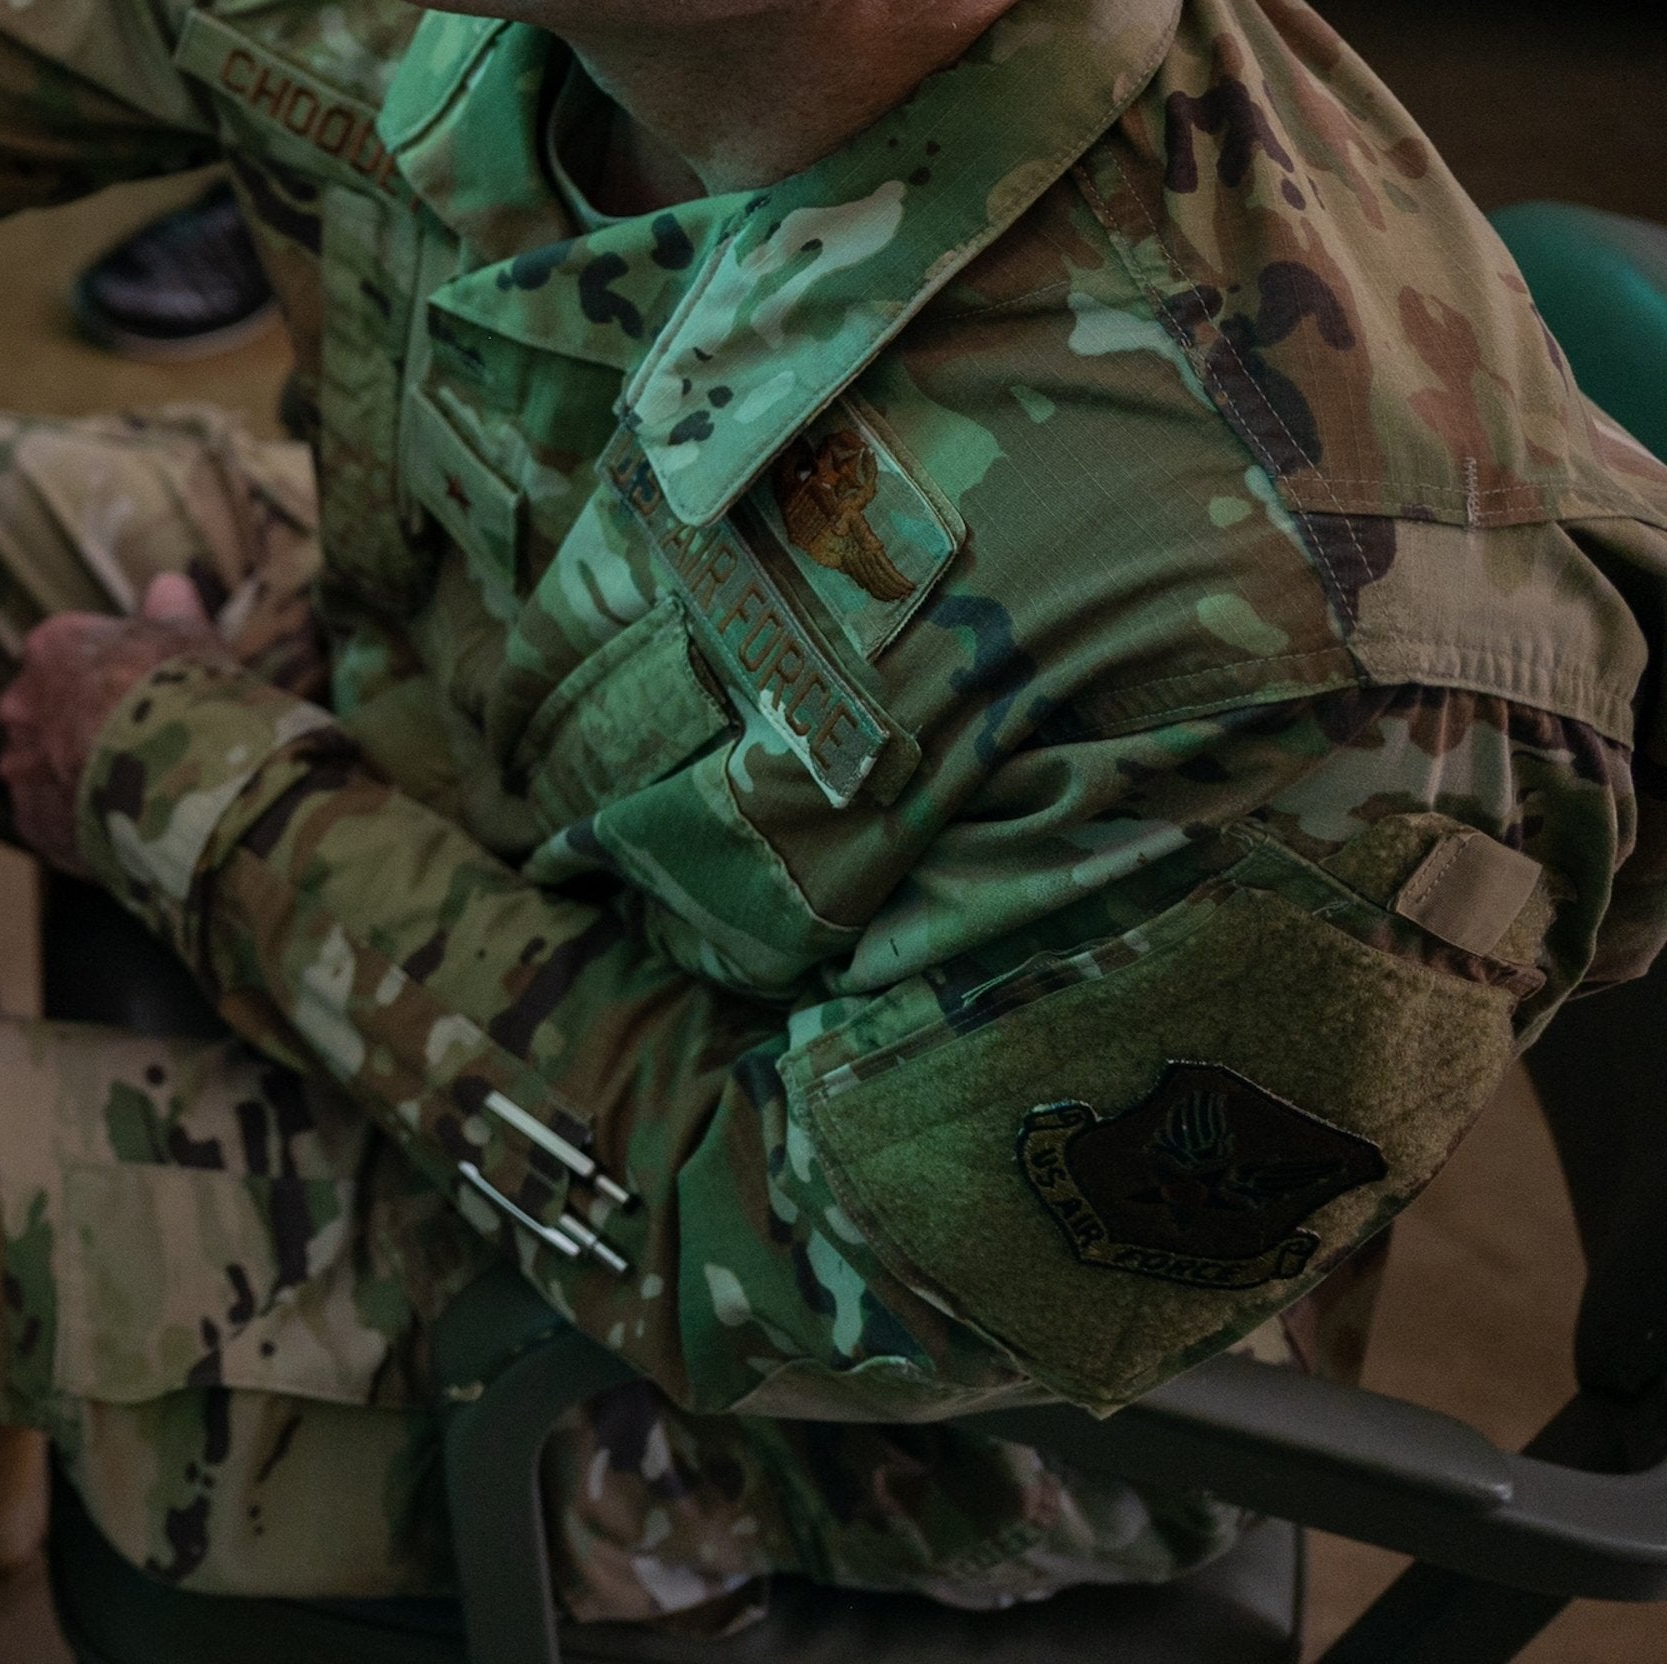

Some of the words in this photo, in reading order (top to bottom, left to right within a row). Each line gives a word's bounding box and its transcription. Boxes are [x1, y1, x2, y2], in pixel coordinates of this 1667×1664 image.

[661, 522, 739, 611] AIR
[718, 584, 860, 772] FORCE
[1030, 1146, 1067, 1186] US
[1053, 1196, 1106, 1247] AIR
[1113, 1246, 1246, 1282] FORCE
